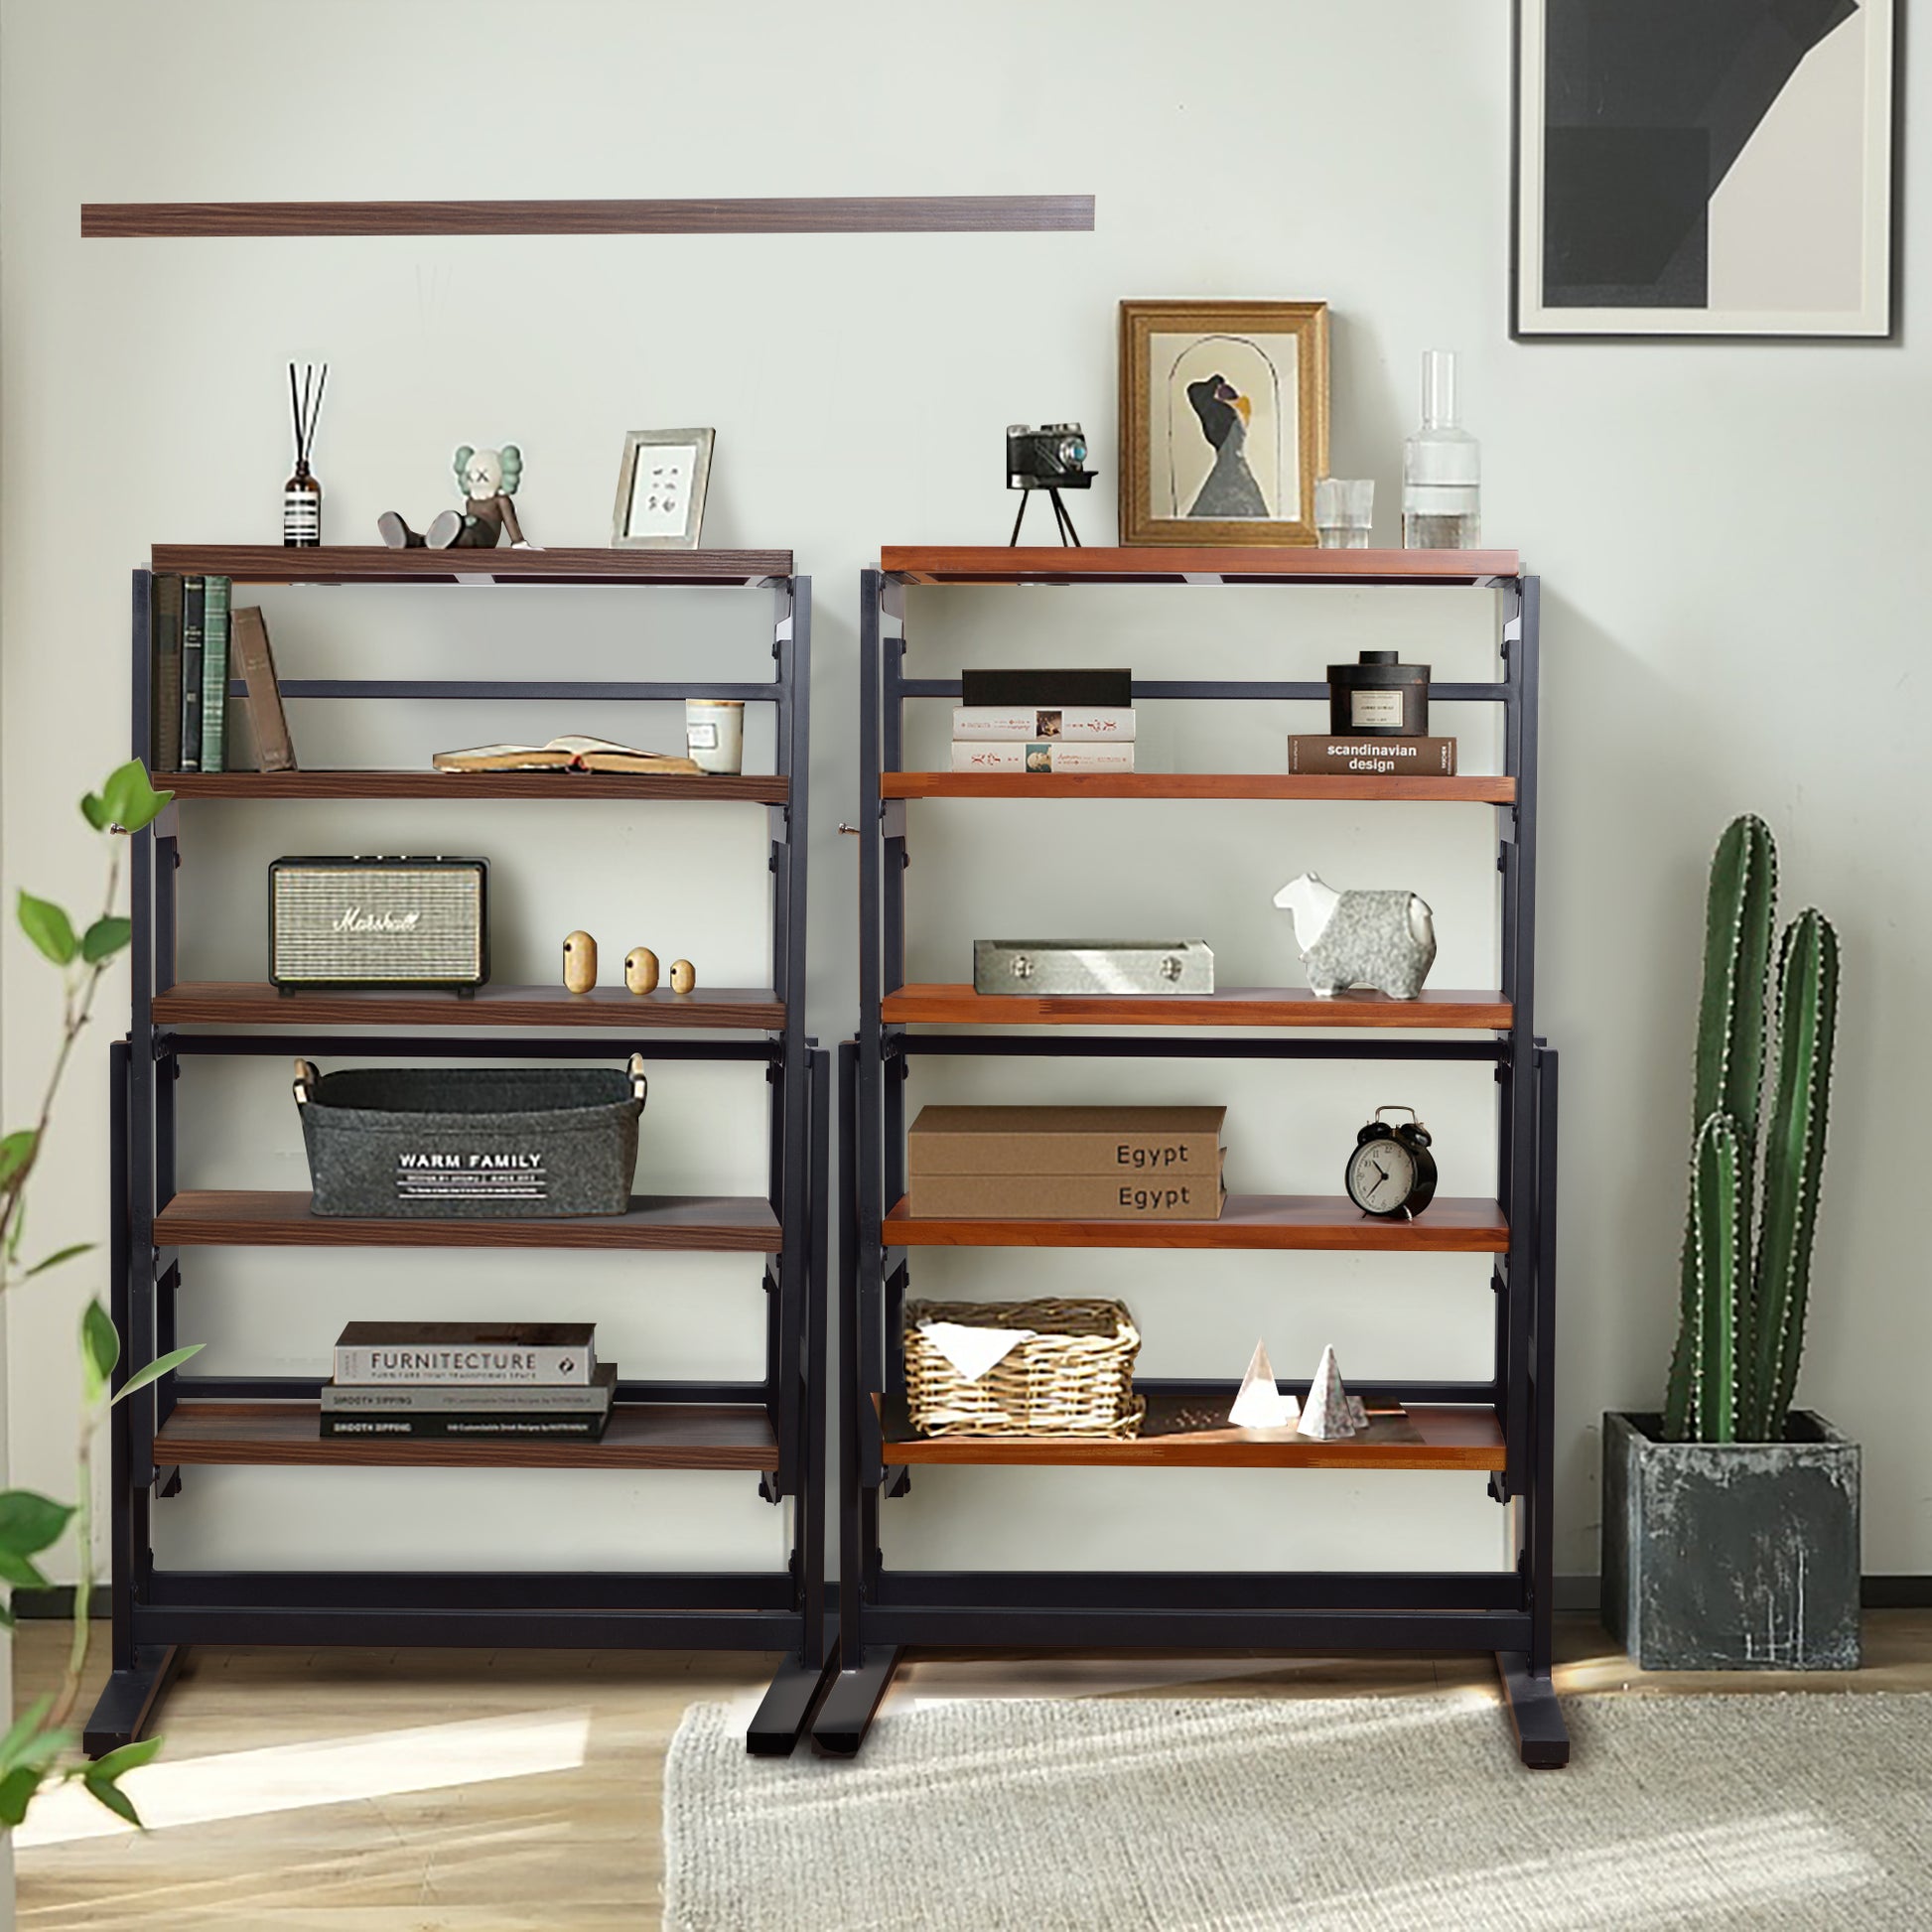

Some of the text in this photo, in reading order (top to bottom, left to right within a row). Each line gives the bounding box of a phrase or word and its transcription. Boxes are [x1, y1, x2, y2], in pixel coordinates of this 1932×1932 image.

[1327, 745, 1417, 757] scandinavian
[1349, 759, 1395, 771] design
[333, 906, 420, 931] Marshall
[399, 1154, 540, 1168] WARM FAMILY
[1117, 1144, 1188, 1168] Egypt
[1119, 1186, 1189, 1209] Egypt
[371, 1353, 535, 1369] FURNITECTURE
